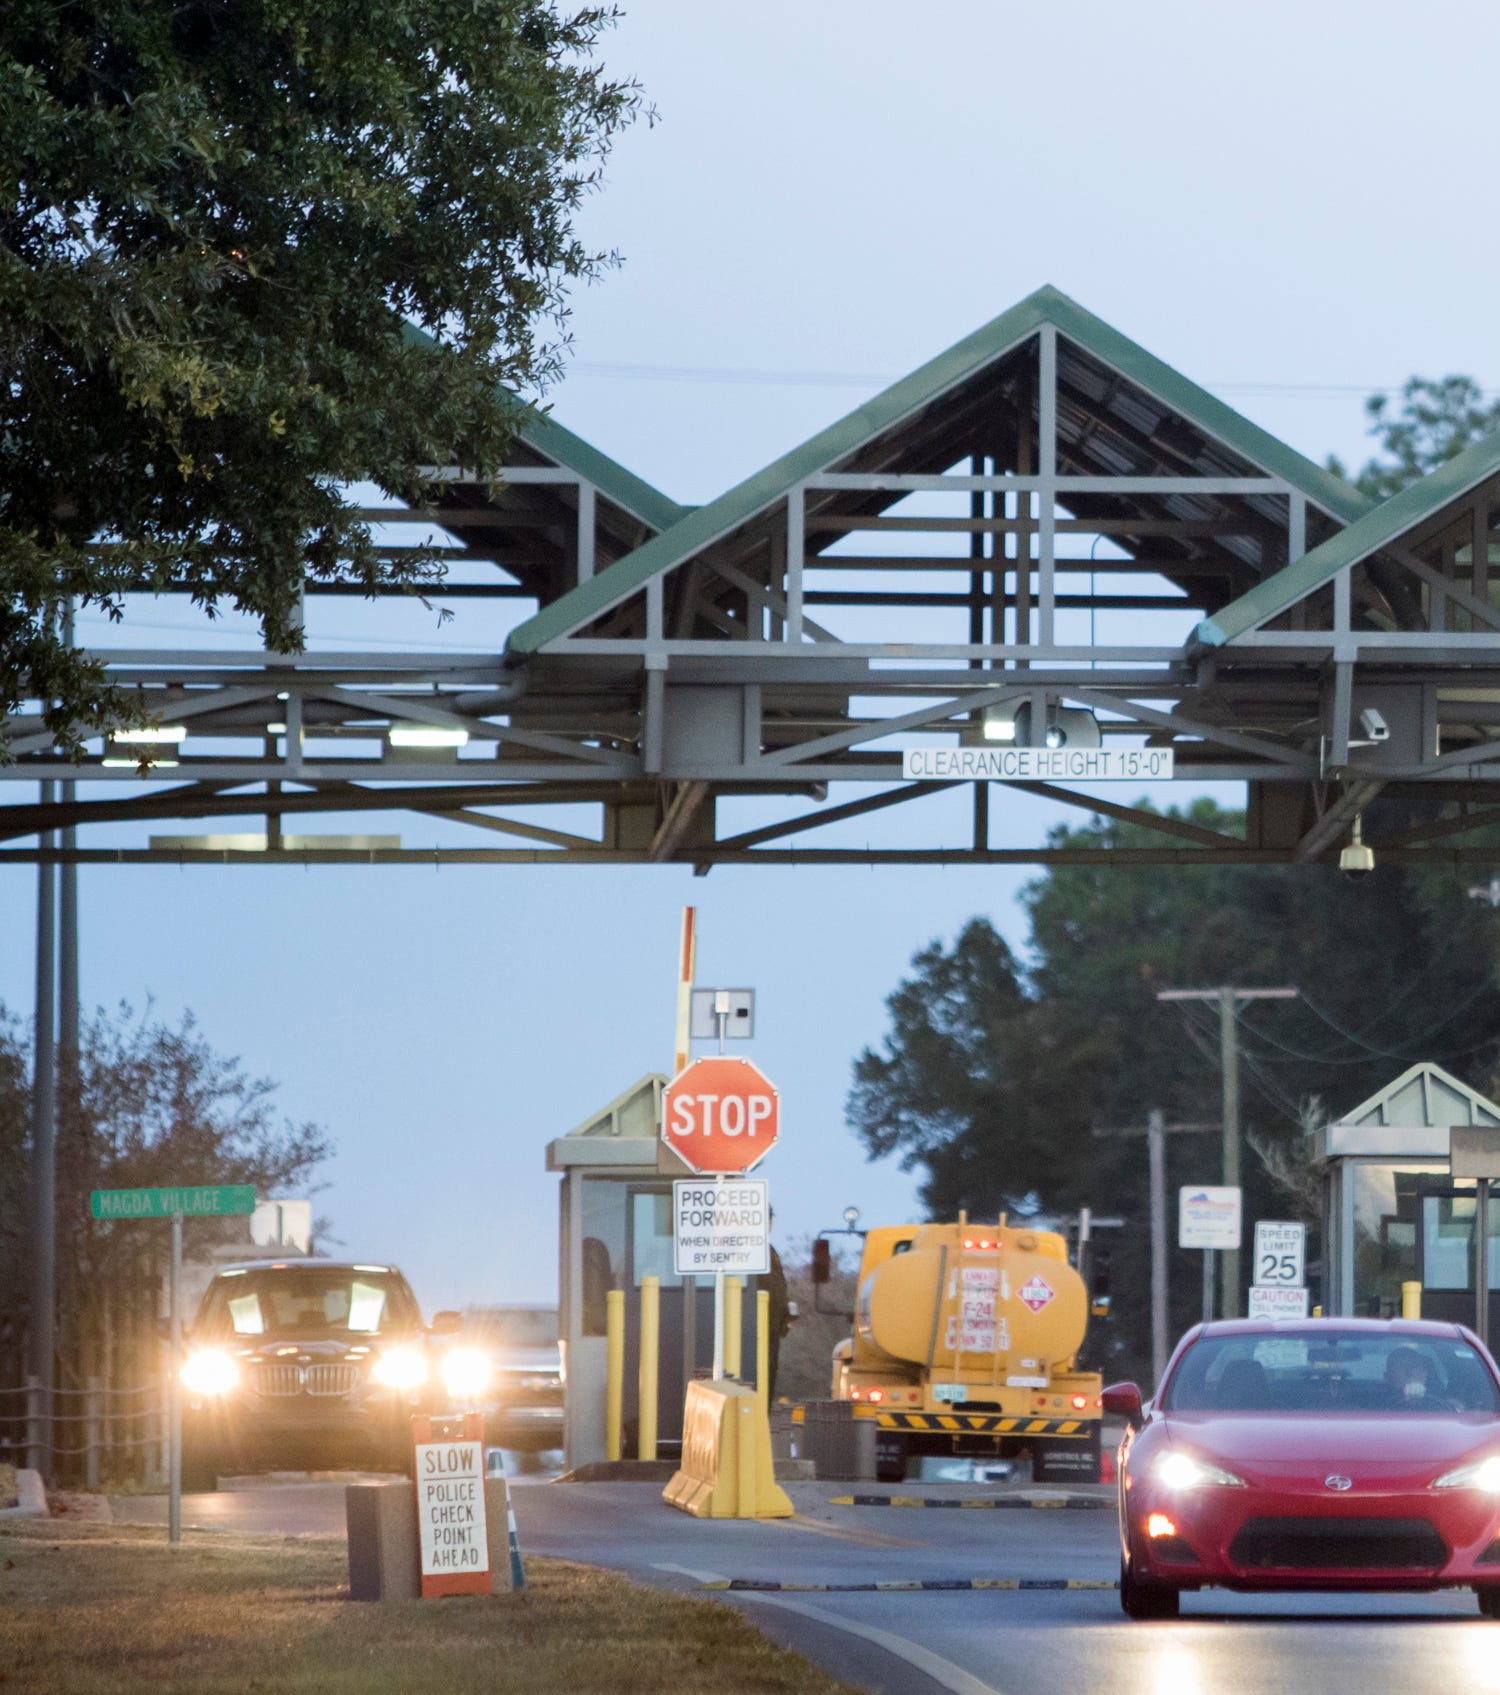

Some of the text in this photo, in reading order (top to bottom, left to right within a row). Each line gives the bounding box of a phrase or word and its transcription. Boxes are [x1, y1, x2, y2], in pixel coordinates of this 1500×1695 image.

[909, 752, 1167, 776] CLEARANCE HEIGHT 15'-0"
[671, 1094, 772, 1137] STOP
[160, 1190, 221, 1212] VILLAGE
[681, 1190, 761, 1208] PROCEED
[680, 1210, 763, 1227] FORWARD
[679, 1236, 764, 1248] WHEN DIRECTED
[1260, 1229, 1300, 1240] SPEED
[1263, 1241, 1296, 1251] LIMIT
[693, 1252, 751, 1264] BY SENTRY
[1261, 1254, 1297, 1281] 25
[1253, 1290, 1304, 1302] CAUTION
[425, 1449, 474, 1474] SLOW
[427, 1483, 476, 1502] POLICE
[431, 1505, 475, 1524] CHECK
[434, 1527, 473, 1546] POINT
[432, 1548, 479, 1567] AHEAD
